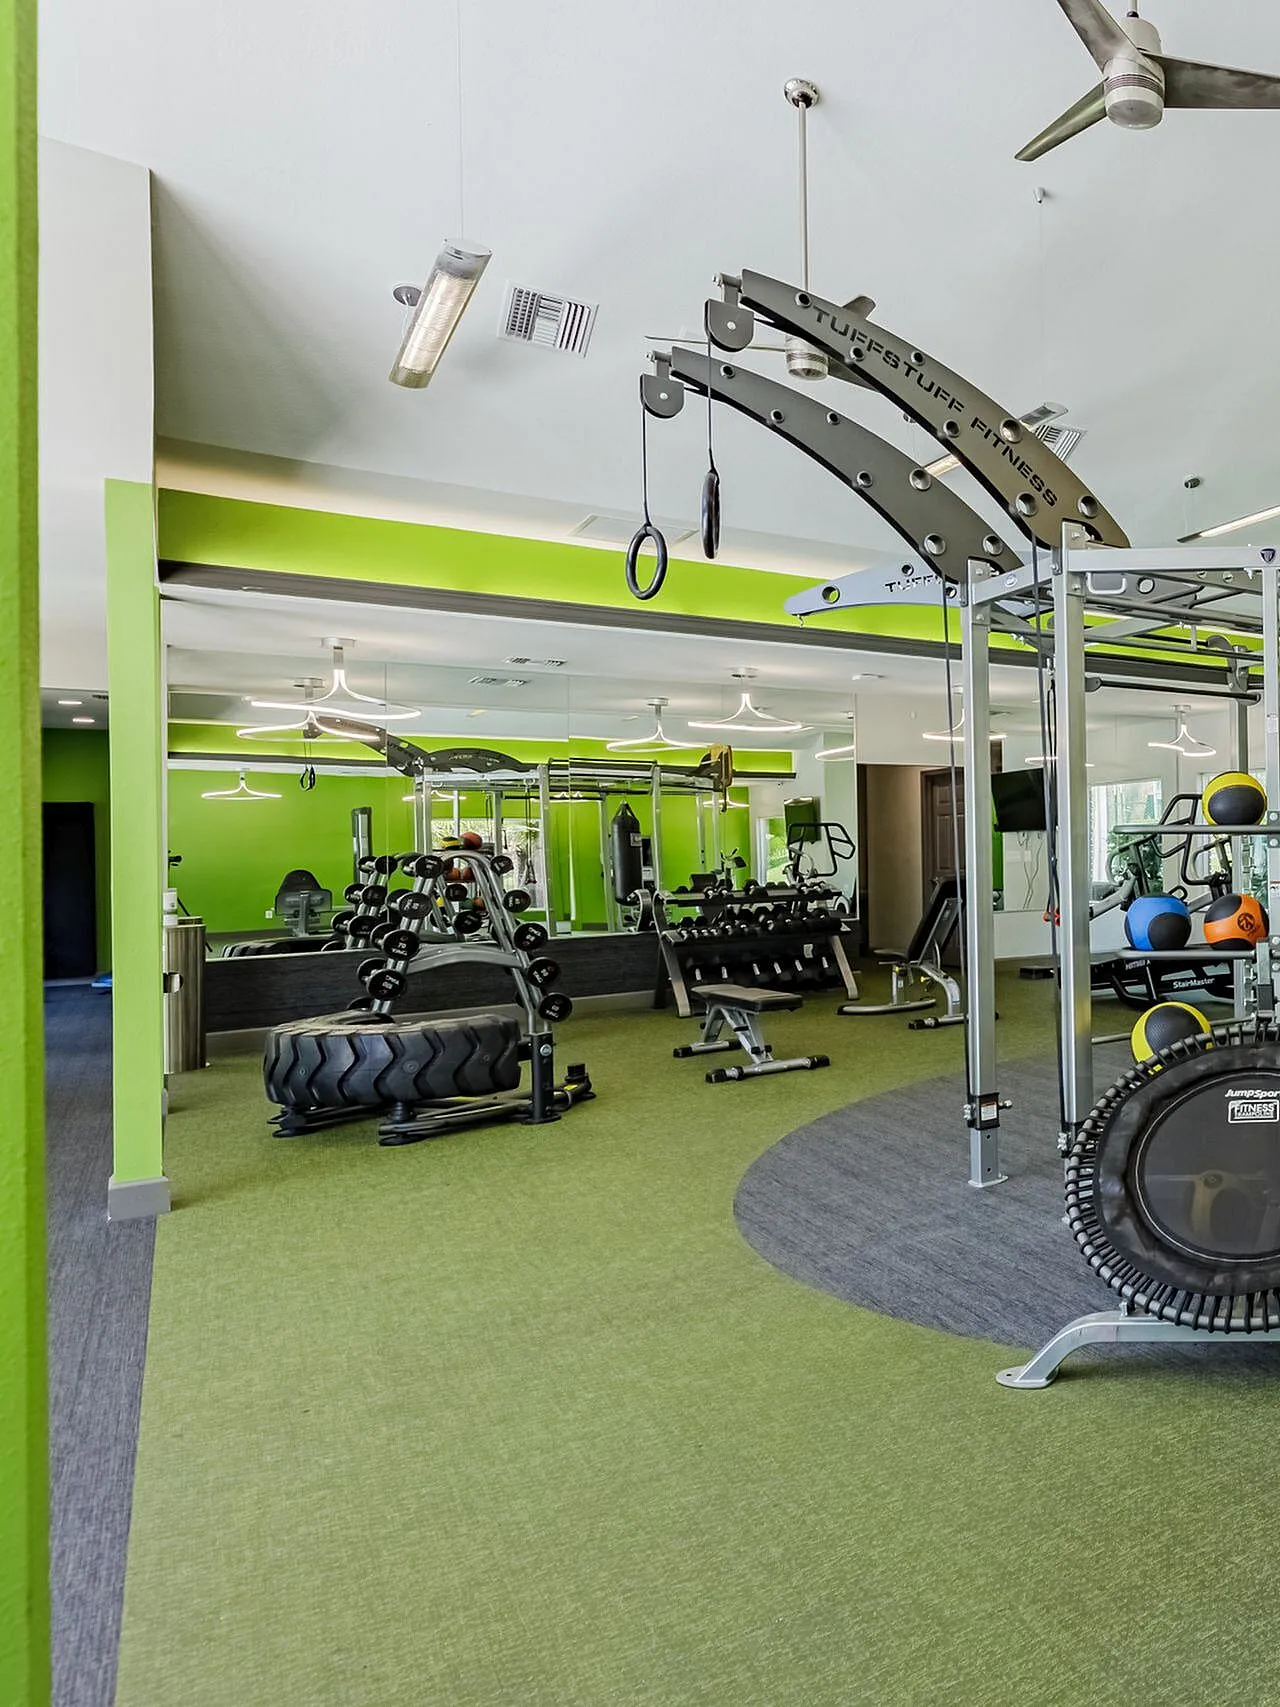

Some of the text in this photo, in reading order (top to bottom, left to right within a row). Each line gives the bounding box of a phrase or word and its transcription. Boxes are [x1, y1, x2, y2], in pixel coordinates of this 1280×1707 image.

[812, 305, 1058, 507] TUFFSTUFF FITNESS
[1172, 978, 1215, 989] StairMaster
[1234, 1103, 1275, 1112] FITNESS
